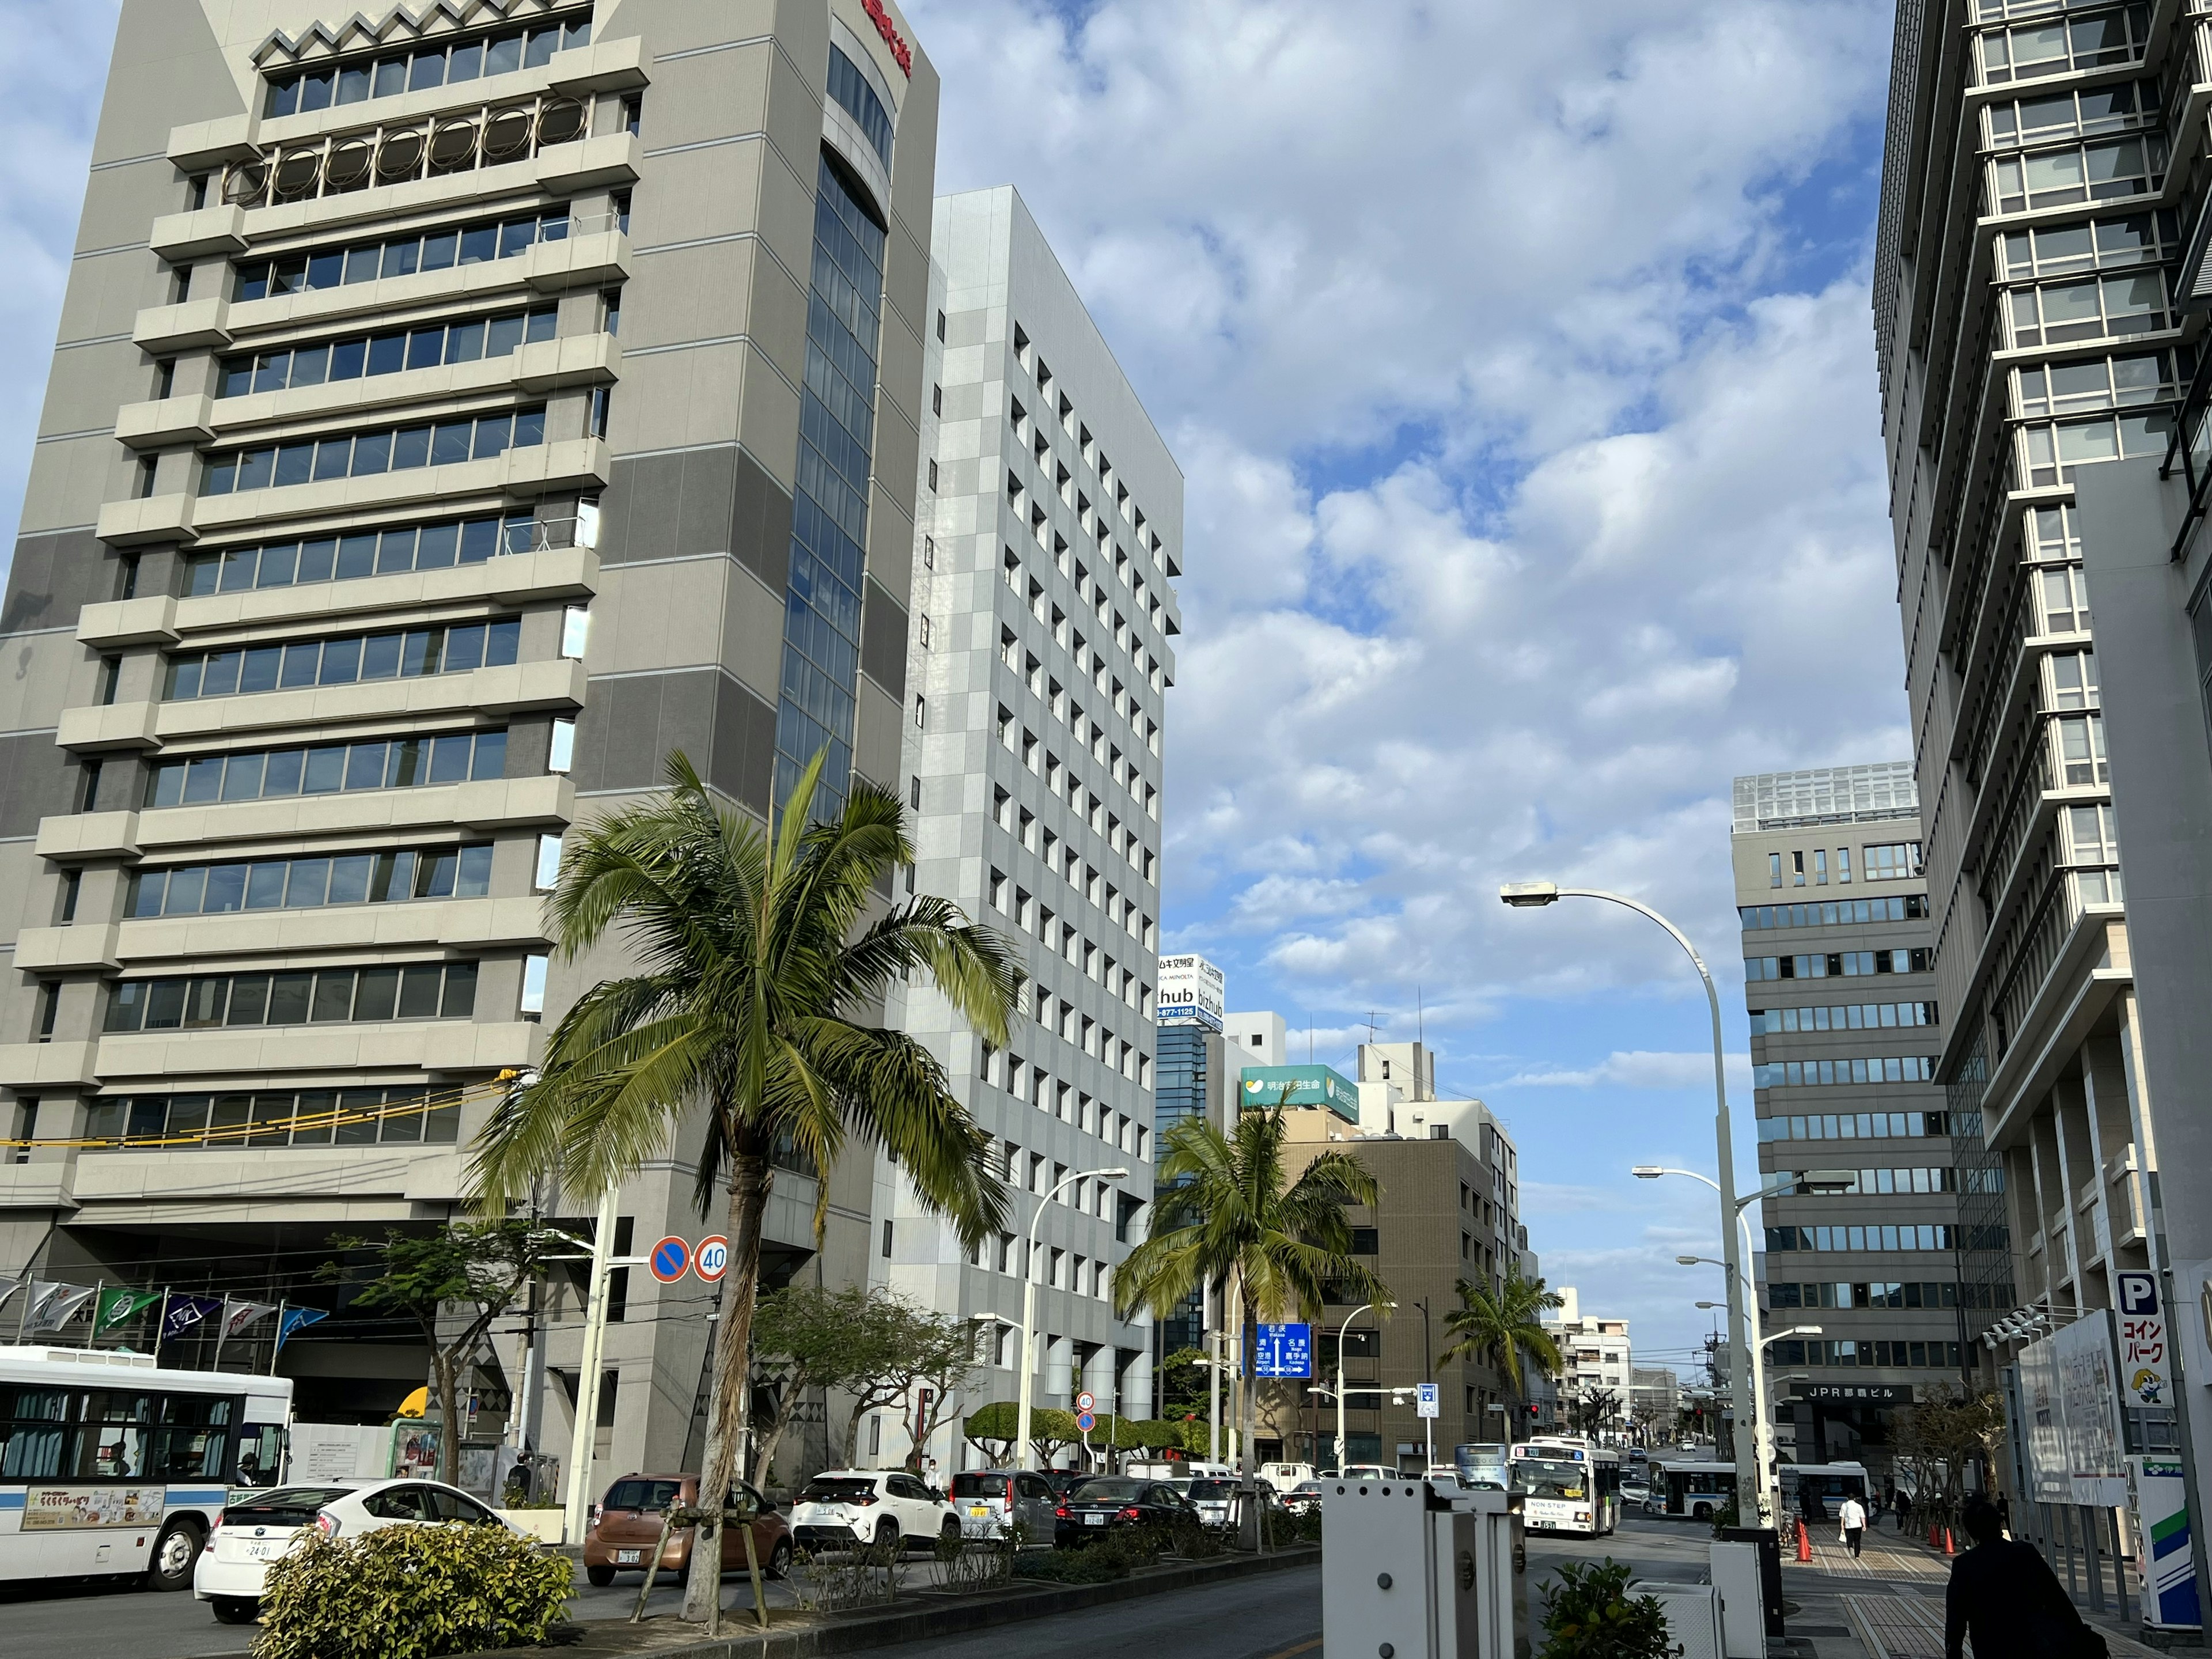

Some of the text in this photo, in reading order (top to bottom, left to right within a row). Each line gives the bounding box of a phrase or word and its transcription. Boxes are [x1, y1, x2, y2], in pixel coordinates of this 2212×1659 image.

[1158, 958, 1194, 968] ムキ文明堂
[1157, 988, 1193, 1003] hub
[1198, 988, 1222, 1018] bizhub
[703, 1248, 724, 1268] 40
[2123, 1278, 2152, 1310] P
[2124, 1320, 2161, 1340] コイン
[2128, 1342, 2162, 1363] パーク
[1081, 1397, 1090, 1406] 40
